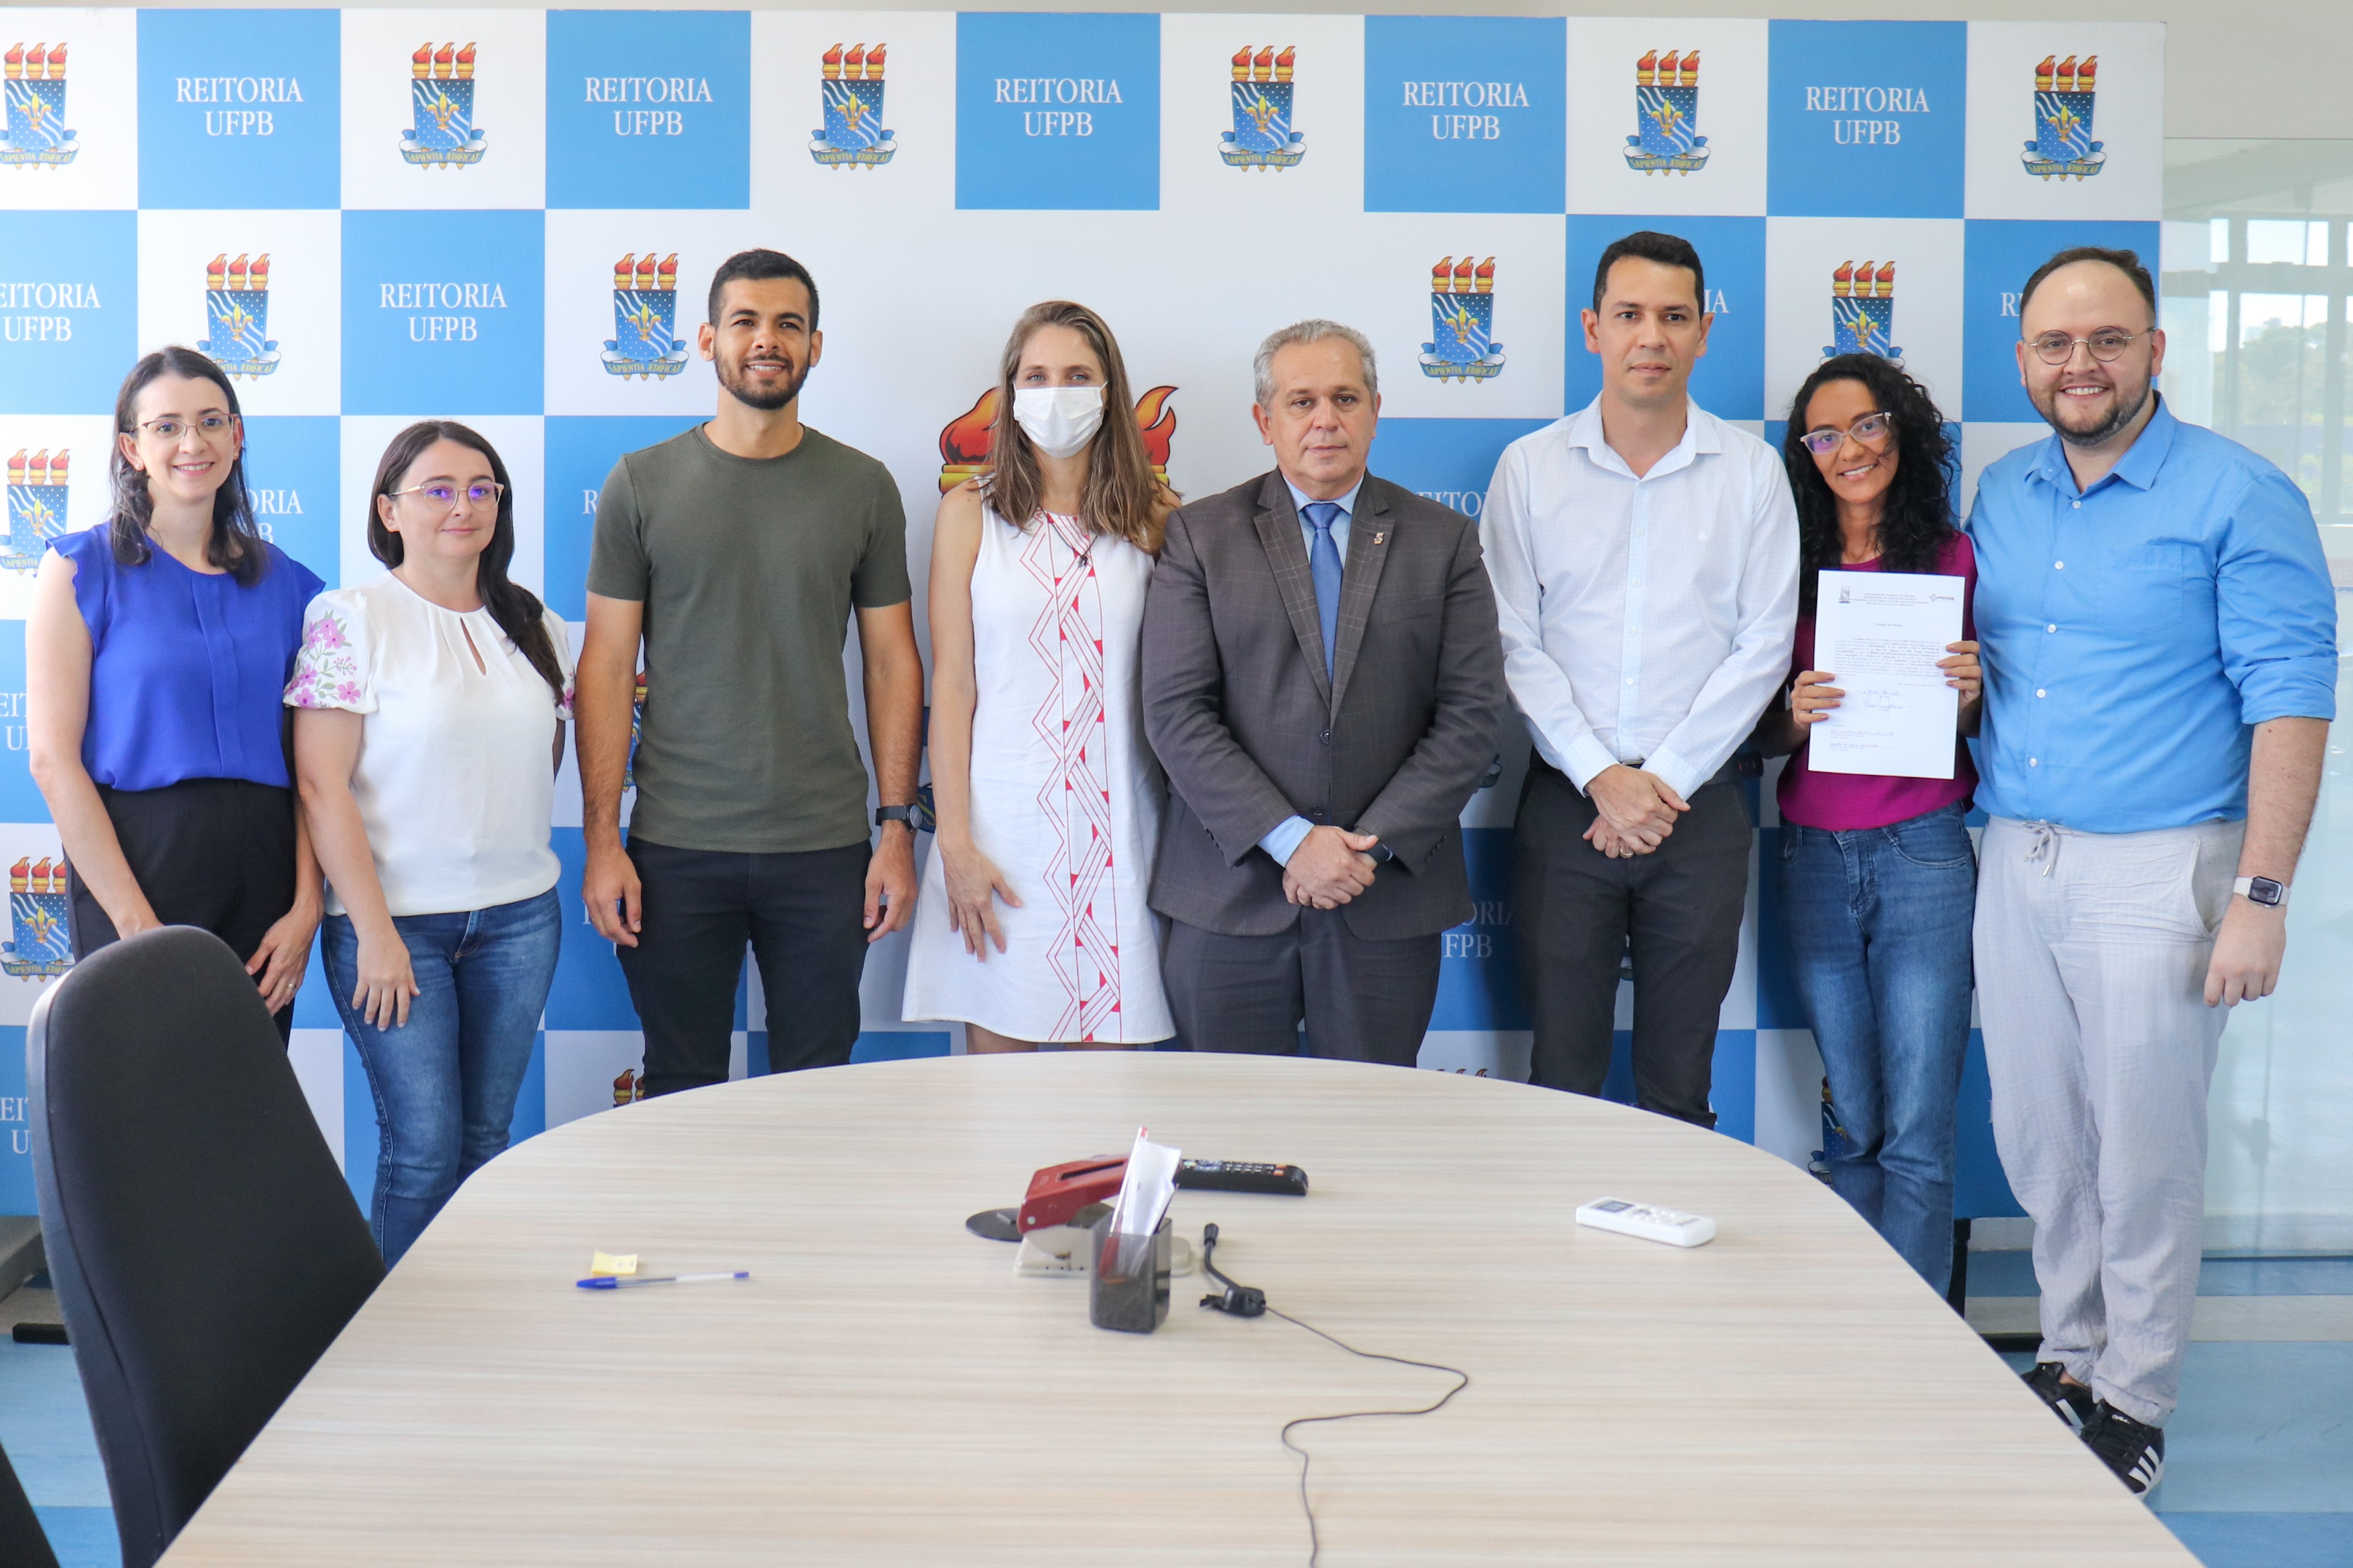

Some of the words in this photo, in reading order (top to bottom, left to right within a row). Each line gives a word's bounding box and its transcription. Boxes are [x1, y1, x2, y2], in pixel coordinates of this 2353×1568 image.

[176, 77, 303, 103] REITORIA
[585, 77, 713, 103] REITORIA
[994, 78, 1123, 104] REITORIA
[1403, 82, 1530, 107] REITORIA
[1806, 86, 1930, 113] REITORIA
[206, 111, 274, 136] UFPB
[614, 110, 683, 136] UFPB
[1024, 111, 1093, 137] UFPB
[1432, 115, 1500, 140] UFPB
[1834, 119, 1901, 145] UFPB
[380, 283, 507, 308] REITORIA
[5, 316, 71, 341] UFPB
[409, 316, 477, 342] UFPB
[1442, 933, 1492, 958] FPB
